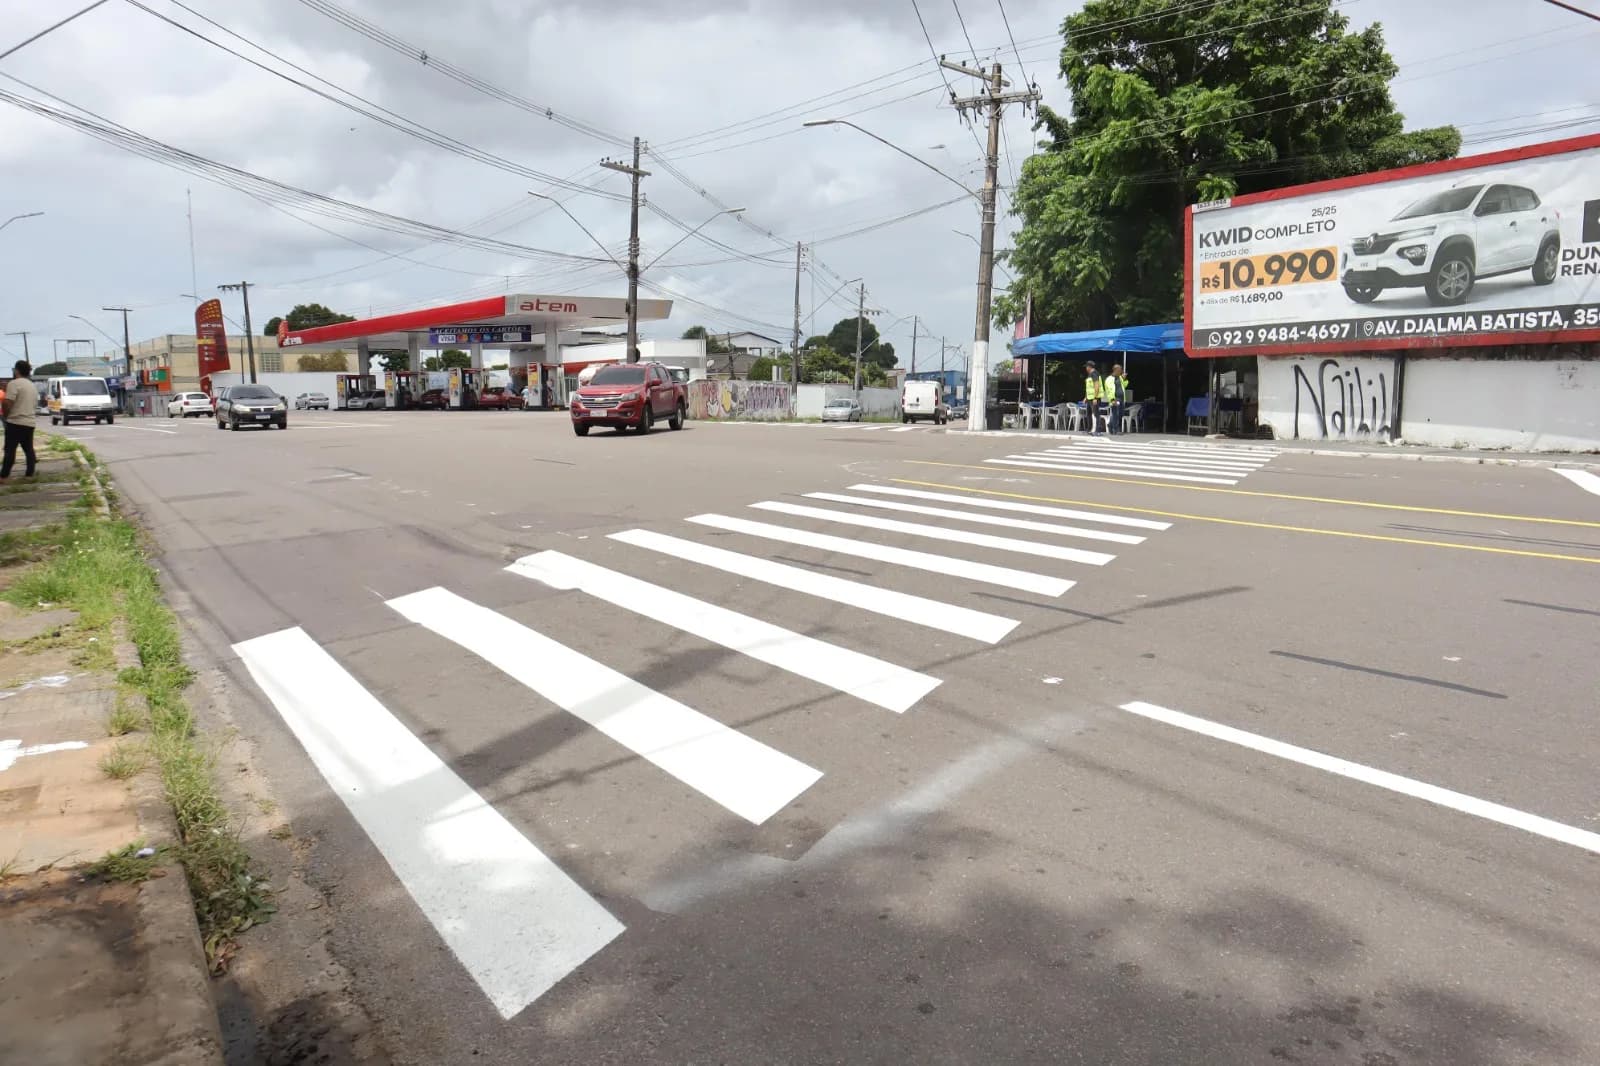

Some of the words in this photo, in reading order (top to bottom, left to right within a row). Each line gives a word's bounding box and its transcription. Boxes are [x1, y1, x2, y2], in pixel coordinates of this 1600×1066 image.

[1311, 205, 1337, 217] 25/25
[1199, 226, 1253, 249] KWID
[1254, 219, 1336, 241] COMPLETO
[1204, 249, 1237, 260] Entrada
[519, 298, 577, 313] atem
[1374, 319, 1400, 336] AV.
[1403, 314, 1475, 334] DJALMA
[1481, 310, 1569, 330] BATISTA,
[1223, 331, 1242, 345] 92
[1245, 330, 1254, 344] 9
[1258, 323, 1350, 342] 9484-4697
